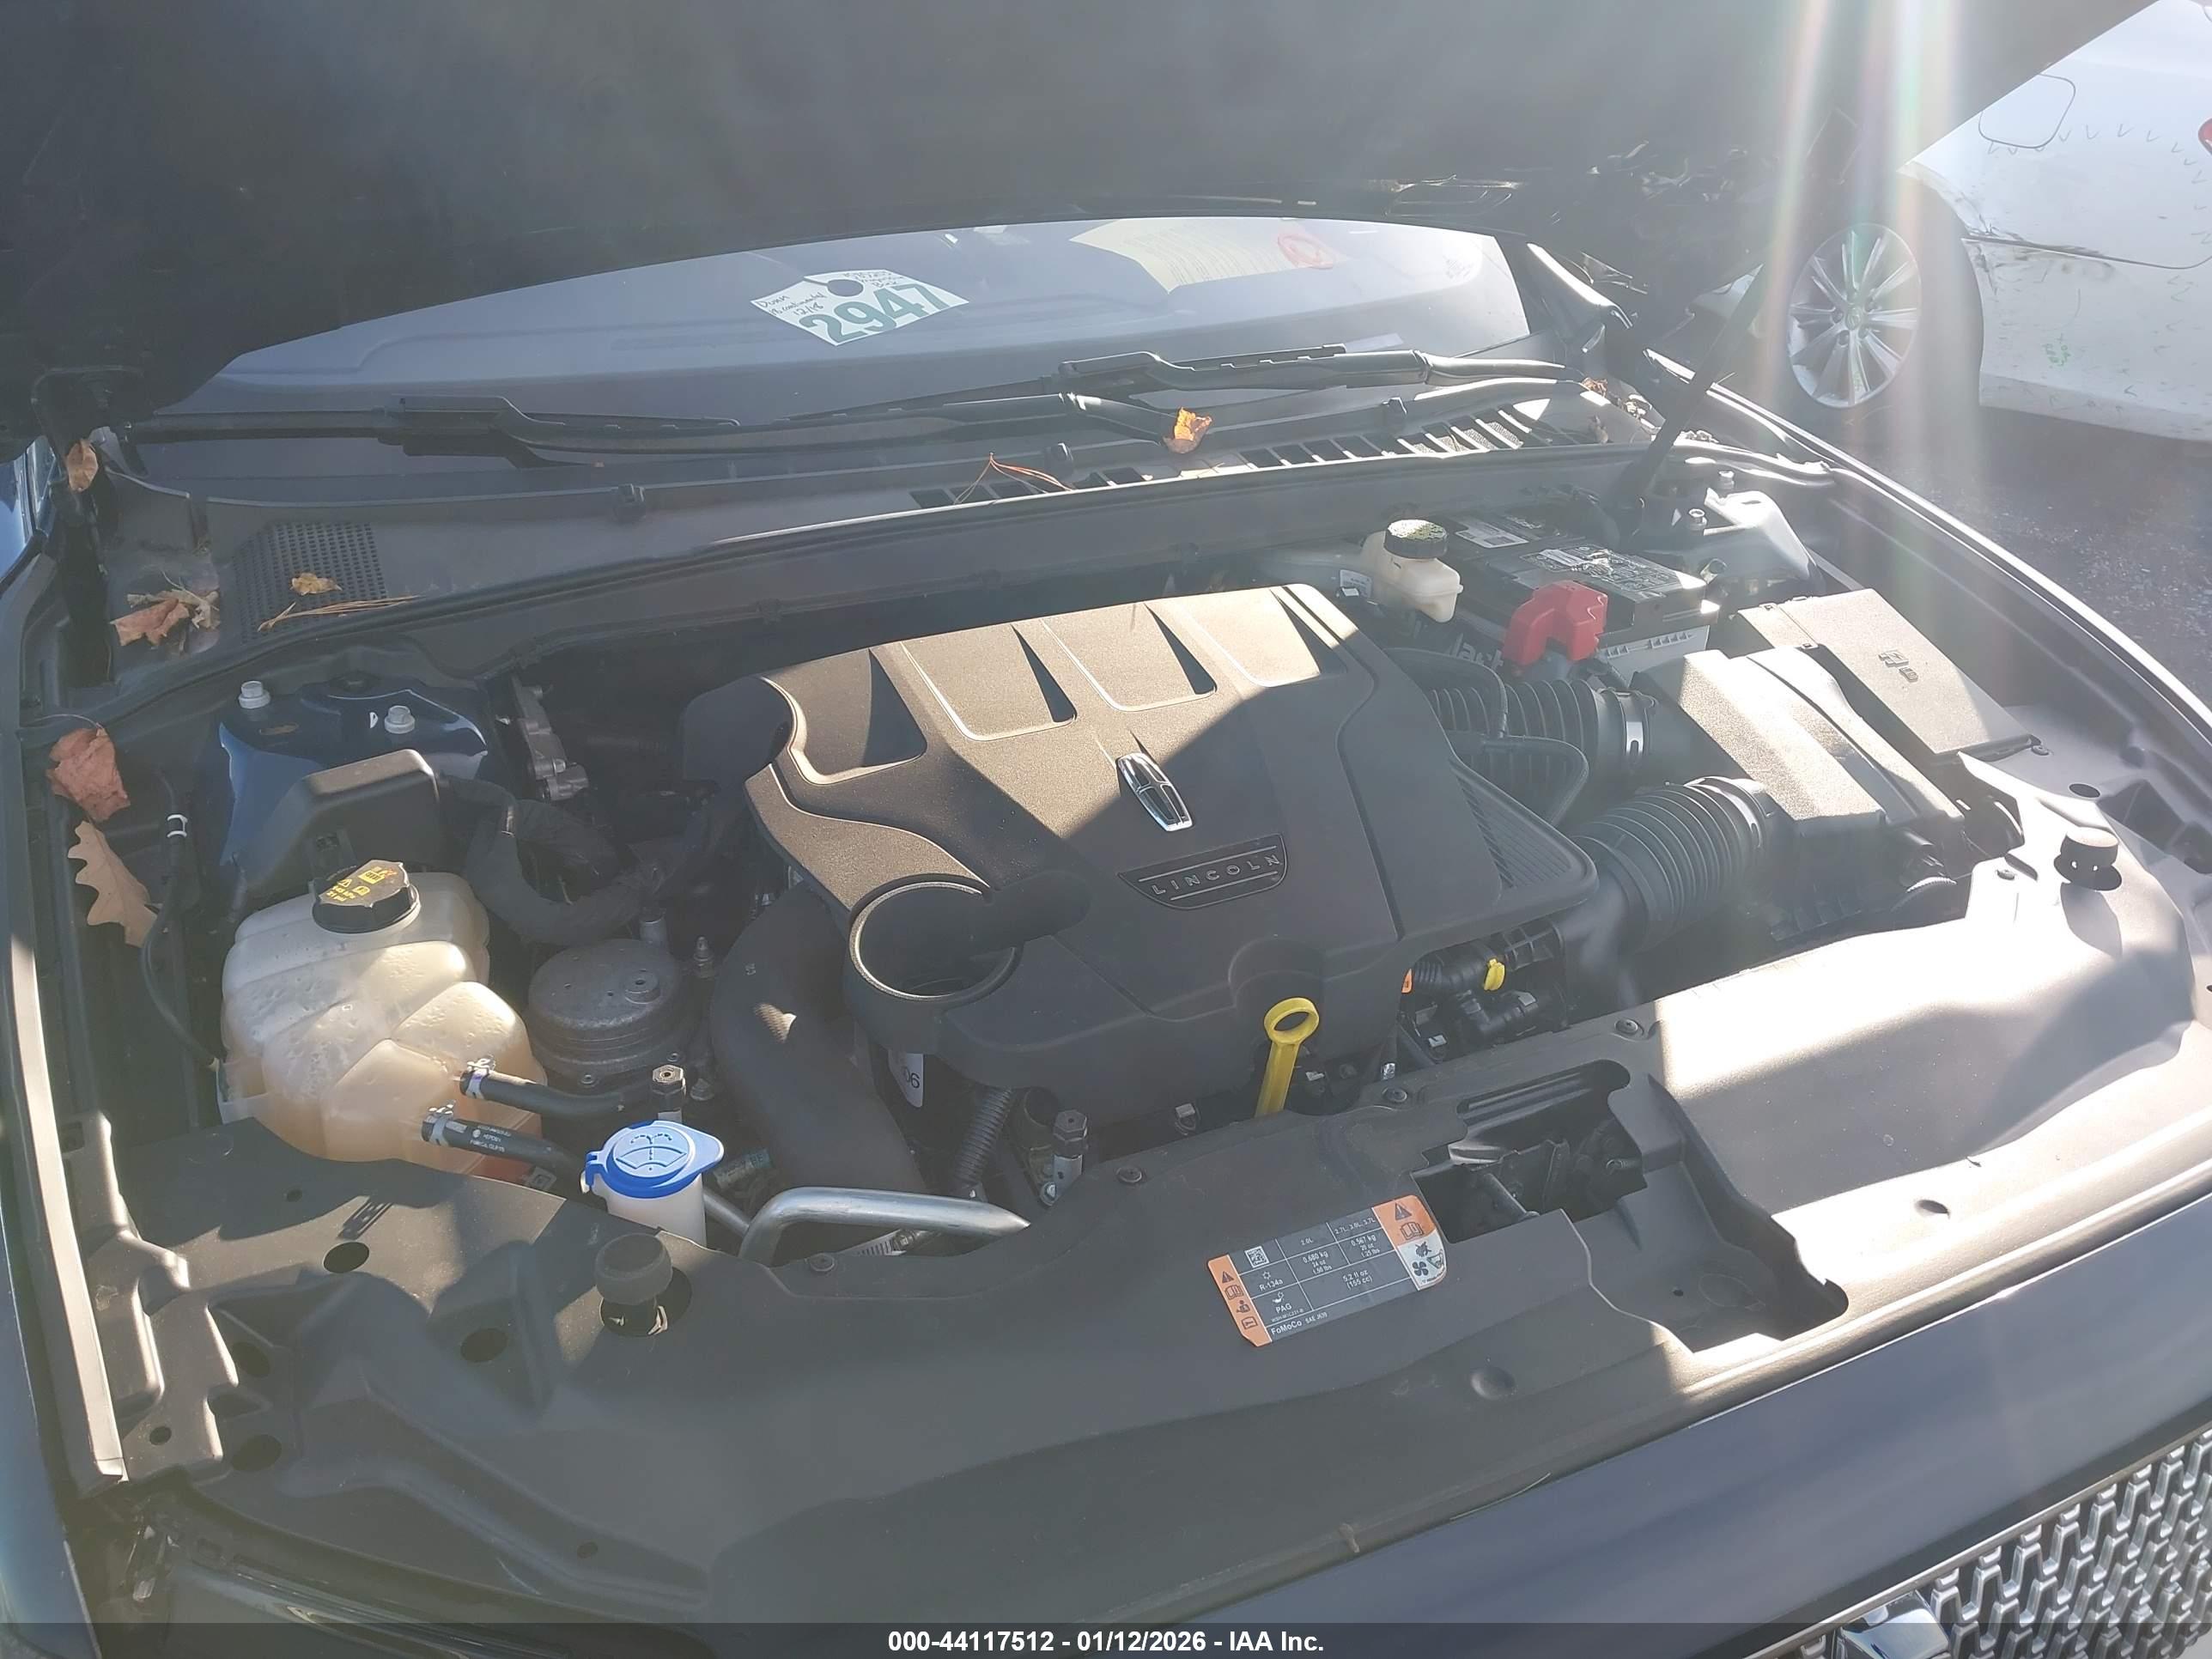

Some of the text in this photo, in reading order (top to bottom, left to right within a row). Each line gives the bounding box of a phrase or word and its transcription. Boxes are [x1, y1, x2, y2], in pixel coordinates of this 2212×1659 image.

[799, 283, 951, 343] 2947
[1152, 854, 1279, 895] LINCOLN
[1259, 1279, 1284, 1291] R-134a
[1347, 1275, 1373, 1290] (155 cc)
[1275, 1303, 1292, 1313] PAG
[1271, 1320, 1303, 1335] FoMoCo
